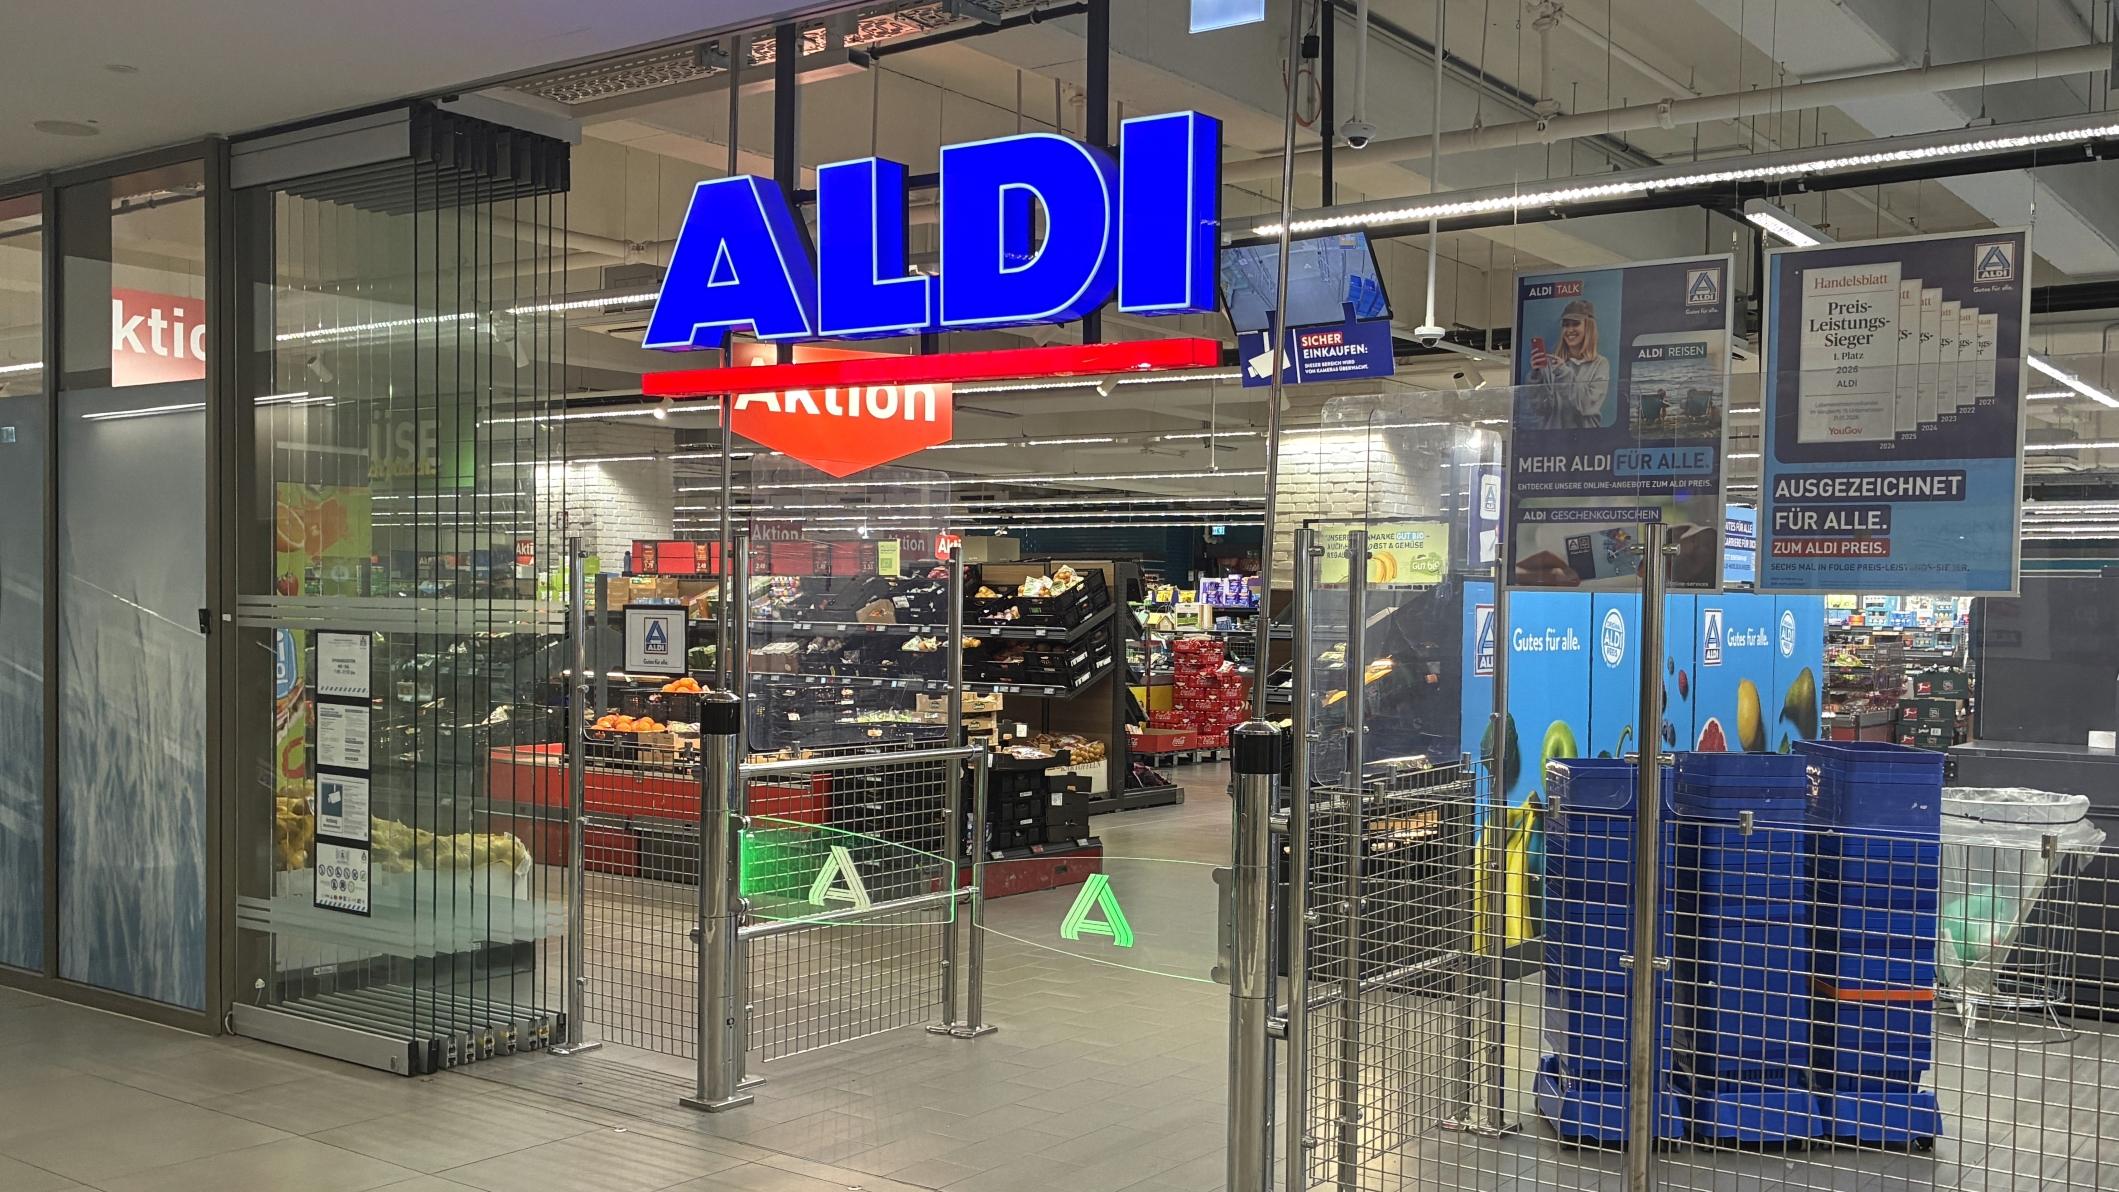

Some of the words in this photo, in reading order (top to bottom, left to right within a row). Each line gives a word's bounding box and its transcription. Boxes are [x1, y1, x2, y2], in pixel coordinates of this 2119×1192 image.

[642, 110, 1217, 350] ALDI
[1982, 270, 2008, 278] ALDI
[1529, 287, 1552, 297] ALDI
[1556, 282, 1580, 294] TALK
[1814, 274, 1888, 290] Handelsblatt
[1828, 300, 1872, 316] Preis-
[112, 298, 206, 362] ktio
[1810, 315, 1891, 333] Leistungs-
[1302, 334, 1342, 346] SICHER
[1824, 332, 1874, 350] Sieger
[1304, 344, 1368, 358] EINKAUFEN:
[1638, 348, 1663, 358] ALDI
[1668, 346, 1704, 357] REISEN
[1842, 352, 1864, 360] Platz
[1836, 380, 1858, 388] ALDI
[1828, 427, 1863, 436] YouGov
[1519, 456, 1566, 472] MEHR
[1571, 455, 1611, 472] ALDI
[1616, 450, 1650, 470] FÜR
[1658, 452, 1710, 470] ALLE.
[1584, 480, 1650, 489] ONLINE-ANGEBOTE
[1775, 476, 1962, 498] AUSGEZEICHNET
[1523, 512, 1546, 520] ALDI
[1551, 510, 1659, 520] GESCHENKGUTSCHEIN
[1776, 508, 1818, 530] FÜR
[1824, 511, 1888, 530] ALLE.
[1774, 542, 1802, 554] ZUM
[1806, 542, 1837, 554] ALDI
[1842, 542, 1886, 554] PREIS.
[1770, 563, 1797, 571] SECHS
[1512, 627, 1543, 652] Gutes
[1546, 627, 1560, 651] für
[1562, 627, 1580, 650] alle.
[1604, 630, 1622, 648] ALDI
[1727, 628, 1746, 647] Gutes
[1747, 628, 1756, 646] für
[1756, 628, 1768, 646] alle.
[1706, 650, 1718, 659] ALDI
